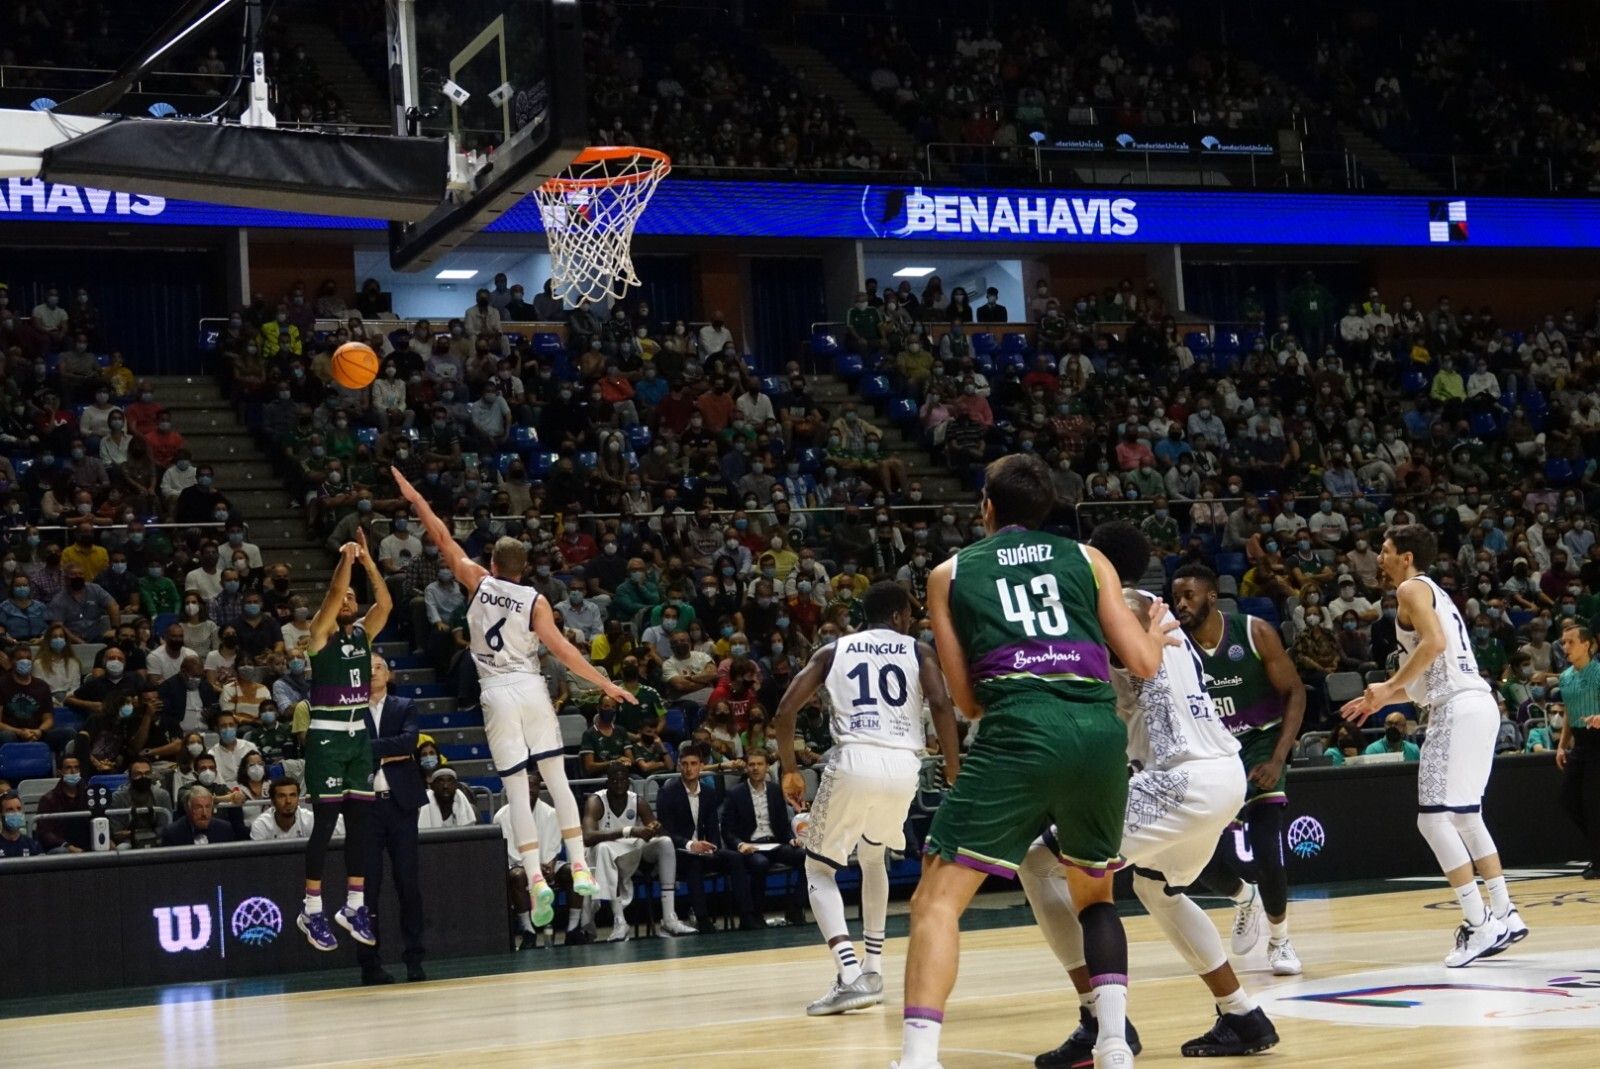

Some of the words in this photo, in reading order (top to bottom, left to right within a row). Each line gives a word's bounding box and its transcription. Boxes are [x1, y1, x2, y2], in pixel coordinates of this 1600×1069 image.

[906, 193, 1139, 236] BENAHAVIS
[996, 543, 1054, 566] SUÁREZ
[480, 592, 524, 613] DUCOTE
[995, 573, 1070, 637] 43
[484, 617, 507, 652] 6
[845, 642, 907, 656] ALINGUE
[349, 668, 361, 688] 13
[846, 662, 908, 707] 10
[1213, 676, 1243, 686] Unicaja
[153, 904, 212, 953] W
